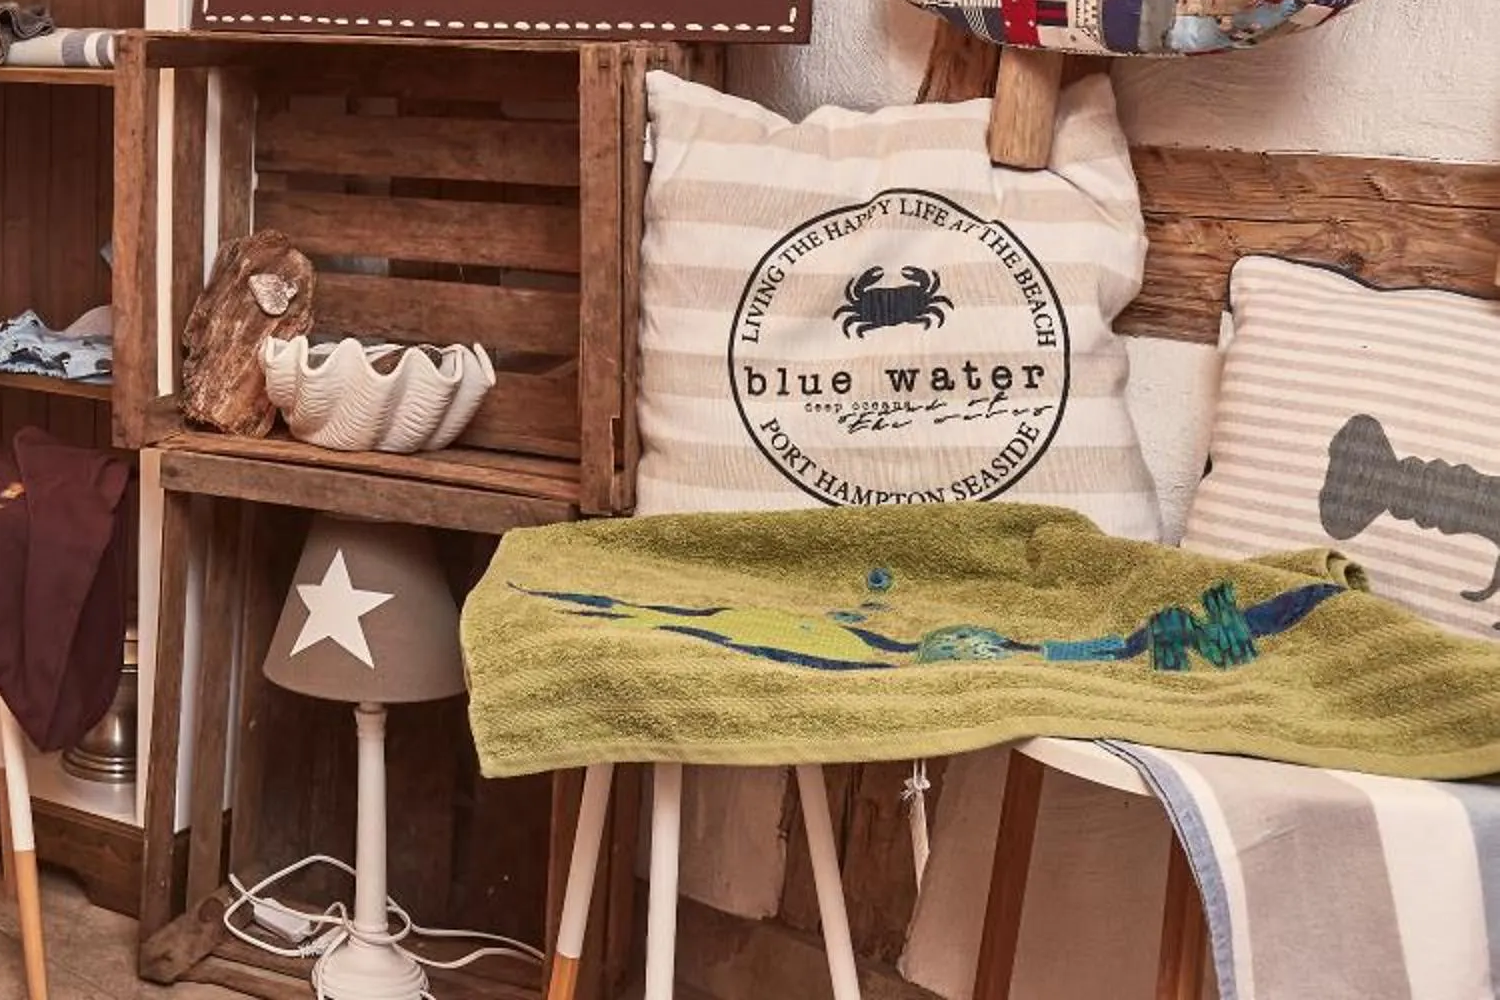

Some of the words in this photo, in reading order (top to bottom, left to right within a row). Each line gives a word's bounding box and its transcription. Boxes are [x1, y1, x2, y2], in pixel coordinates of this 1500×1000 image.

[741, 264, 785, 344] LIVING
[779, 231, 824, 265] THE
[823, 199, 892, 242] HAPPY
[899, 197, 949, 228] LIFE
[979, 225, 1022, 270] THE
[1013, 267, 1058, 348] BEACH
[743, 365, 852, 396] blue
[884, 360, 1045, 396] water
[760, 417, 817, 478] PORT
[814, 469, 946, 505] HAMPTON
[951, 421, 1040, 501] SEASIDE
